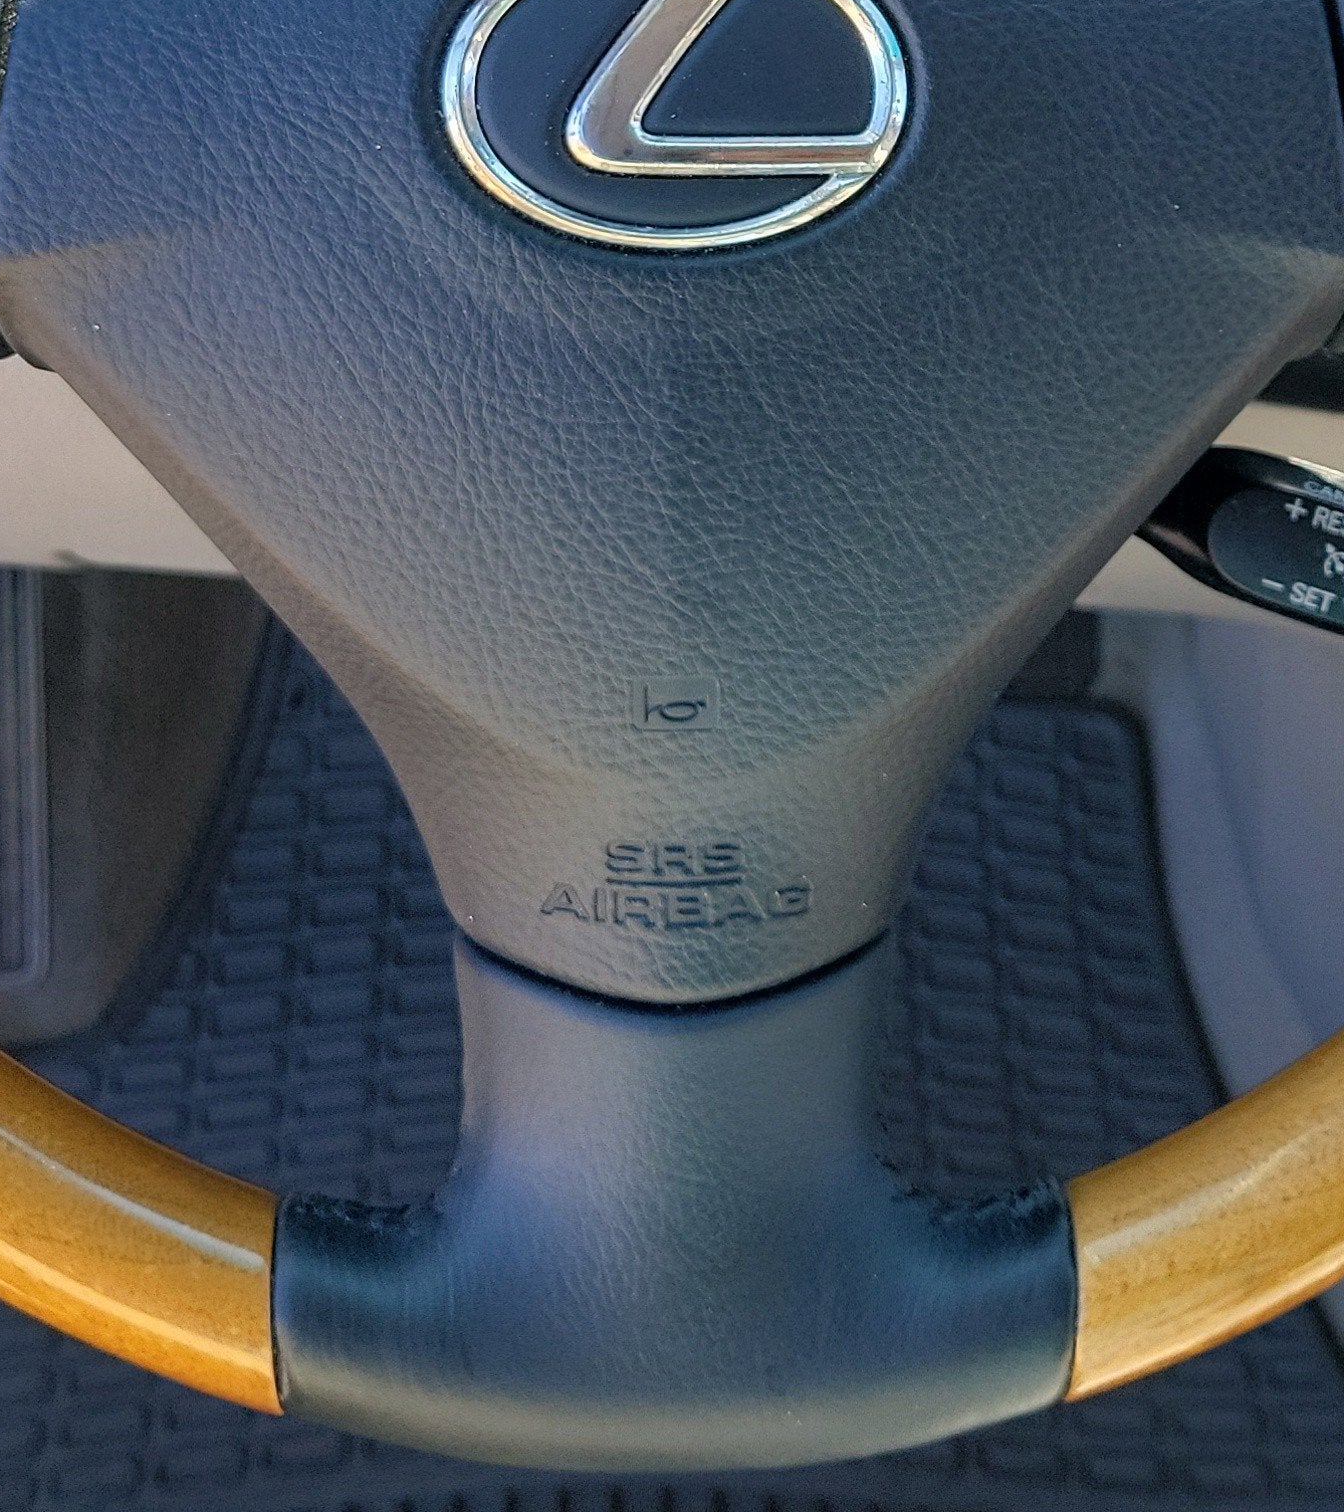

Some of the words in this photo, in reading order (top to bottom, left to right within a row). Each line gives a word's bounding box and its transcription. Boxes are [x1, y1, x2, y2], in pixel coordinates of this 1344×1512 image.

[1288, 580, 1338, 614] SET
[605, 841, 742, 878] SRS
[539, 882, 813, 930] AIRBAG
